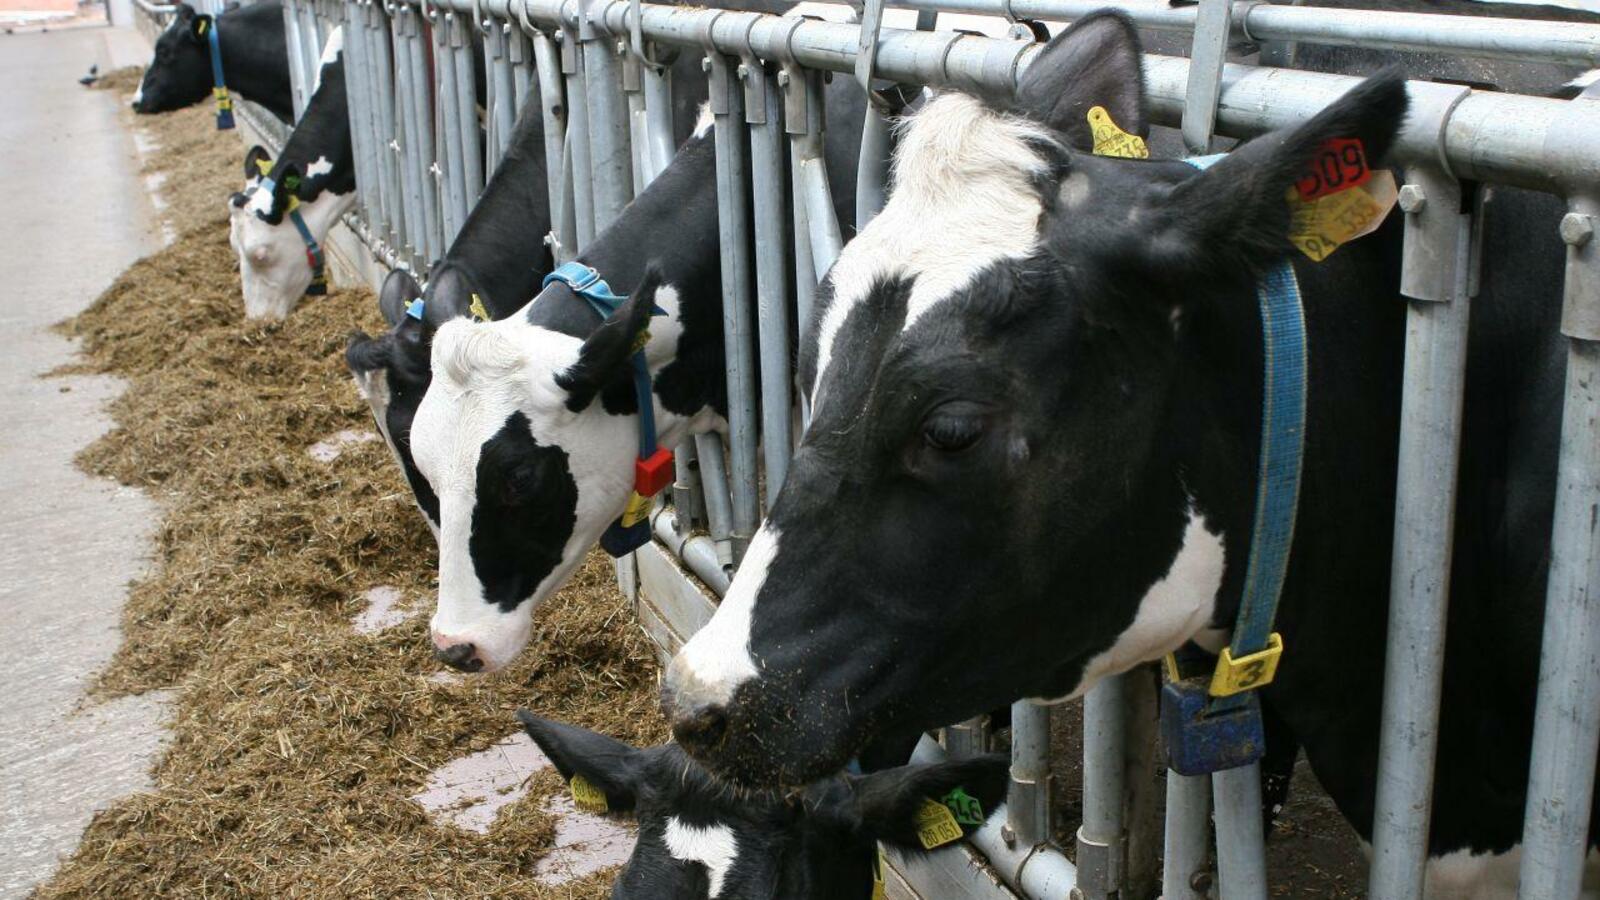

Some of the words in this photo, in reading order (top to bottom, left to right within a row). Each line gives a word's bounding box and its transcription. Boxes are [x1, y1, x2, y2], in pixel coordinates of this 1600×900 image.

[1238, 660, 1266, 688] 3
[922, 828, 939, 847] 80
[937, 821, 961, 841] 051
